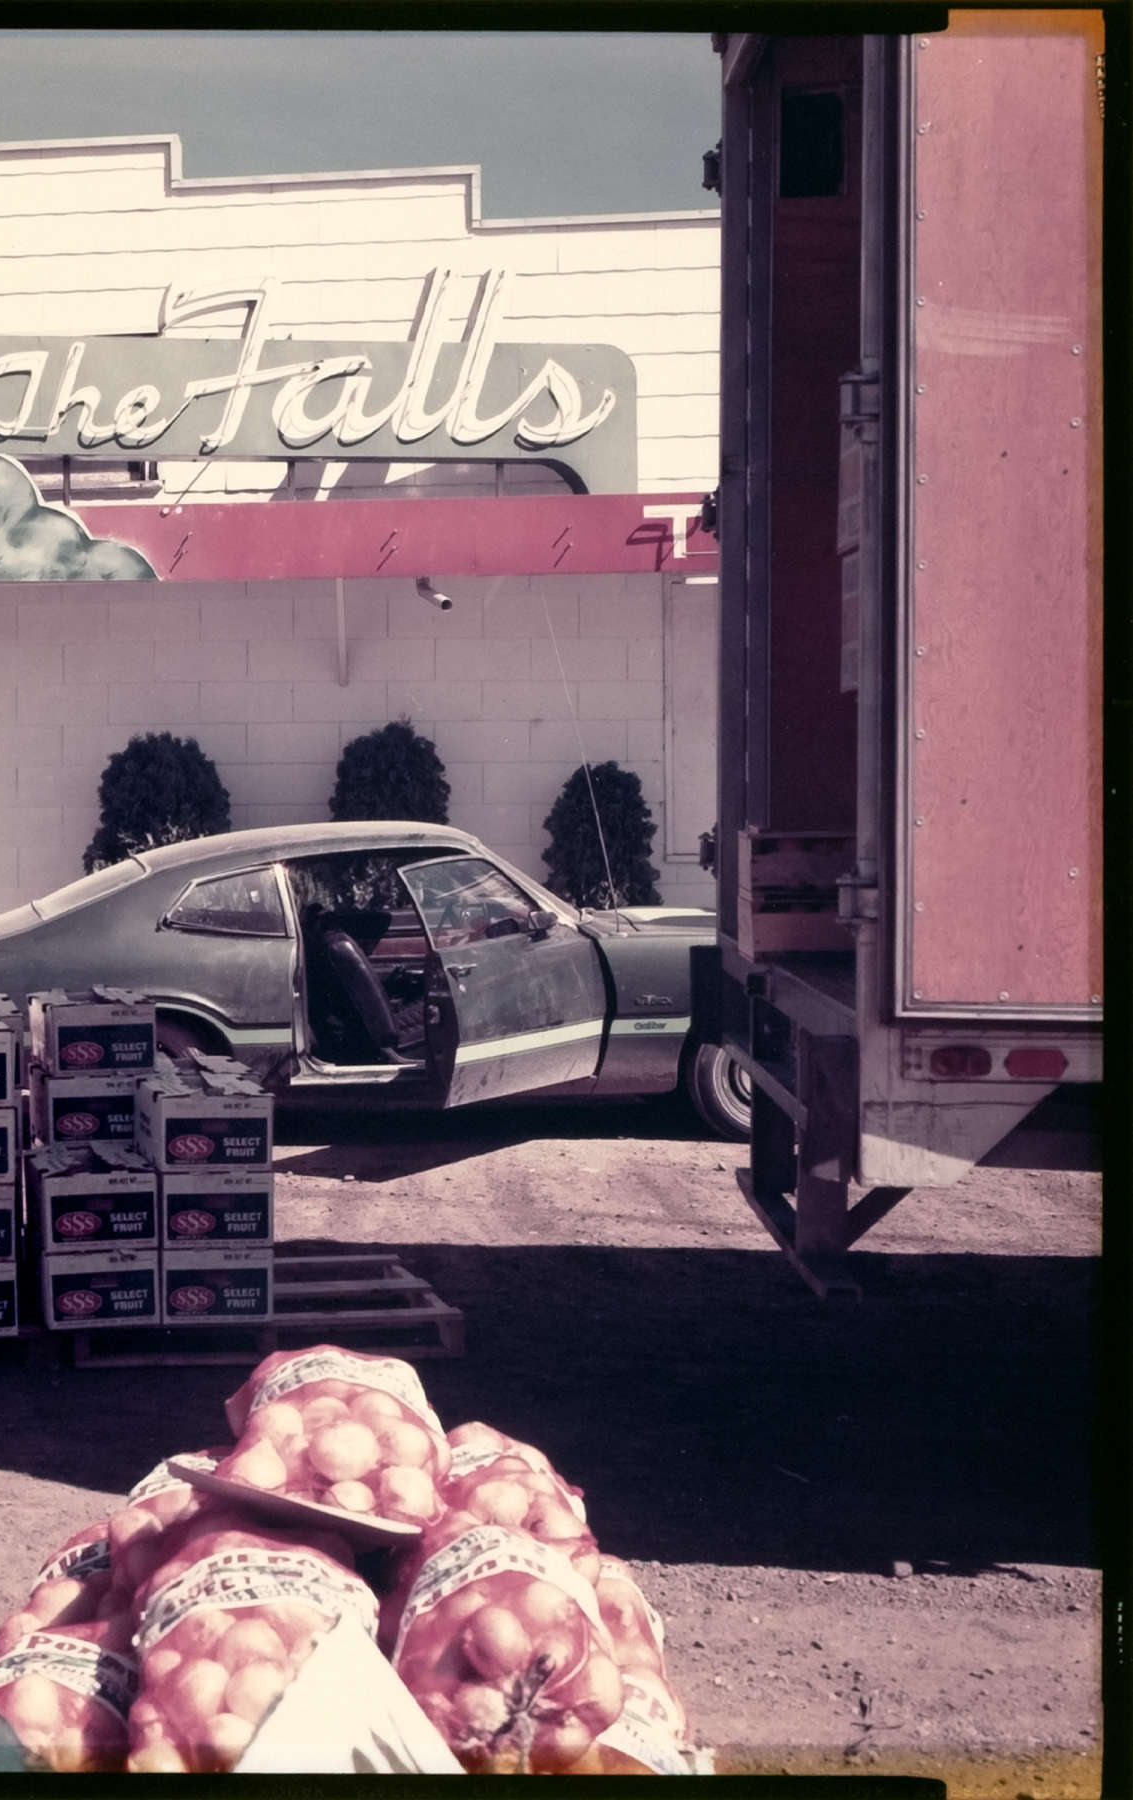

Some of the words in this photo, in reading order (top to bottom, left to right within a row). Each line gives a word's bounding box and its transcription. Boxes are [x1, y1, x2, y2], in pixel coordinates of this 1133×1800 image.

[158, 266, 617, 453] Falls
[111, 1042, 147, 1051] SELECT
[67, 1042, 98, 1063] SSS
[114, 1052, 143, 1061] FRUIT
[63, 1114, 93, 1134] SSS
[176, 1135, 208, 1157] SSS
[223, 1137, 261, 1147] SELECT
[225, 1147, 255, 1157] FRUIT
[109, 1211, 148, 1222] SELECT
[177, 1210, 209, 1232] SSS
[224, 1212, 261, 1221] SELECT
[62, 1211, 95, 1233] SSS
[112, 1222, 144, 1232] FRUIT
[227, 1222, 258, 1231] FRUIT
[110, 1289, 148, 1300] SELECT
[176, 1286, 208, 1308] SSS
[223, 1288, 261, 1297] SELECT
[63, 1290, 95, 1312] SSS
[113, 1300, 144, 1310] FRUIT
[226, 1298, 257, 1308] FRUIT
